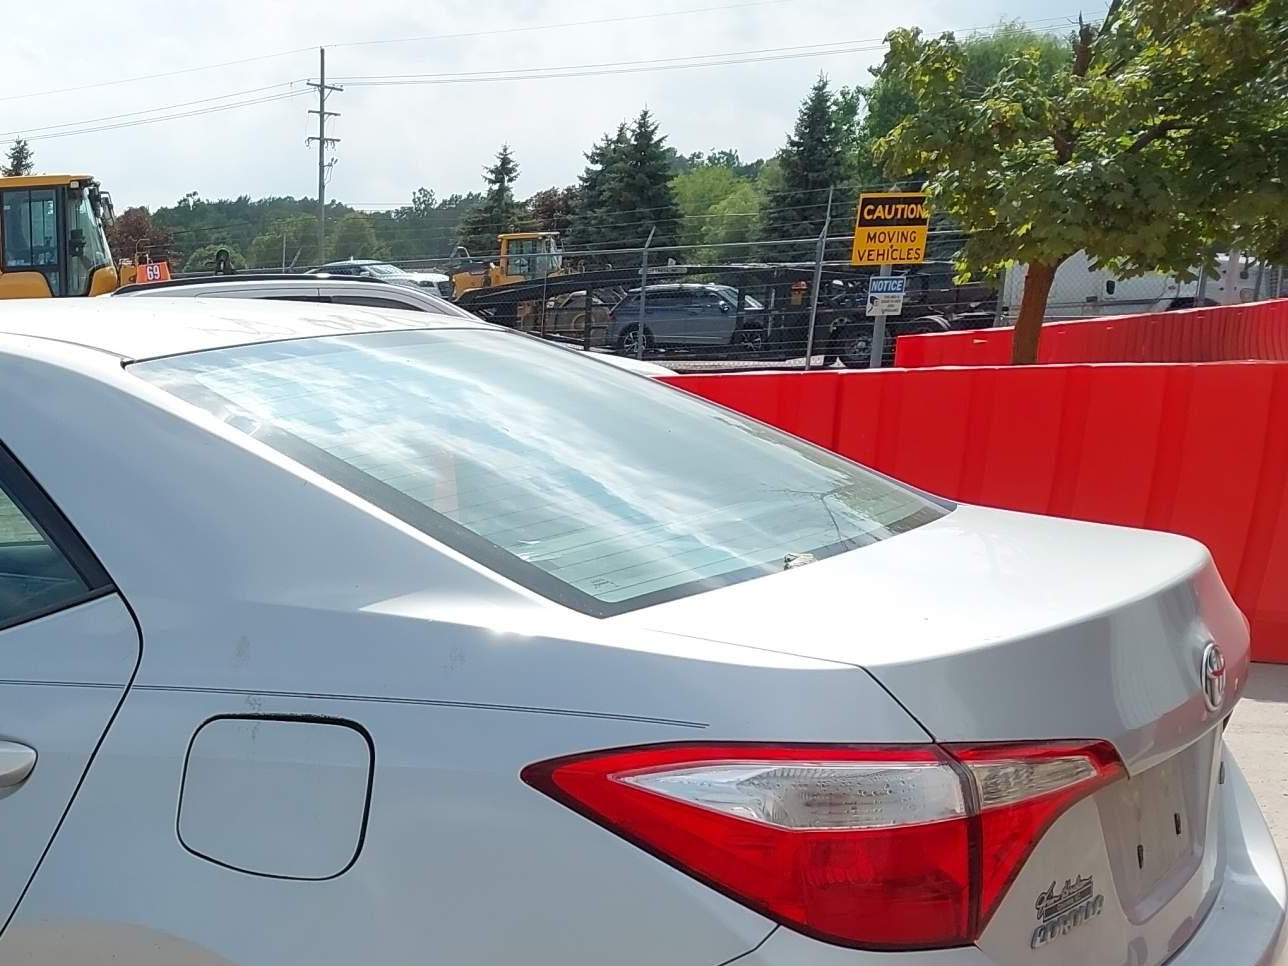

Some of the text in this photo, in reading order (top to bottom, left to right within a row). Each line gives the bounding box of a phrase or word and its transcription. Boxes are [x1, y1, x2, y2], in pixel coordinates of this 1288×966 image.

[864, 204, 927, 220] CAUTION
[866, 231, 916, 244] MOVING
[858, 247, 920, 262] VEHICLES
[146, 265, 161, 281] 69
[871, 280, 903, 291] NOTICE
